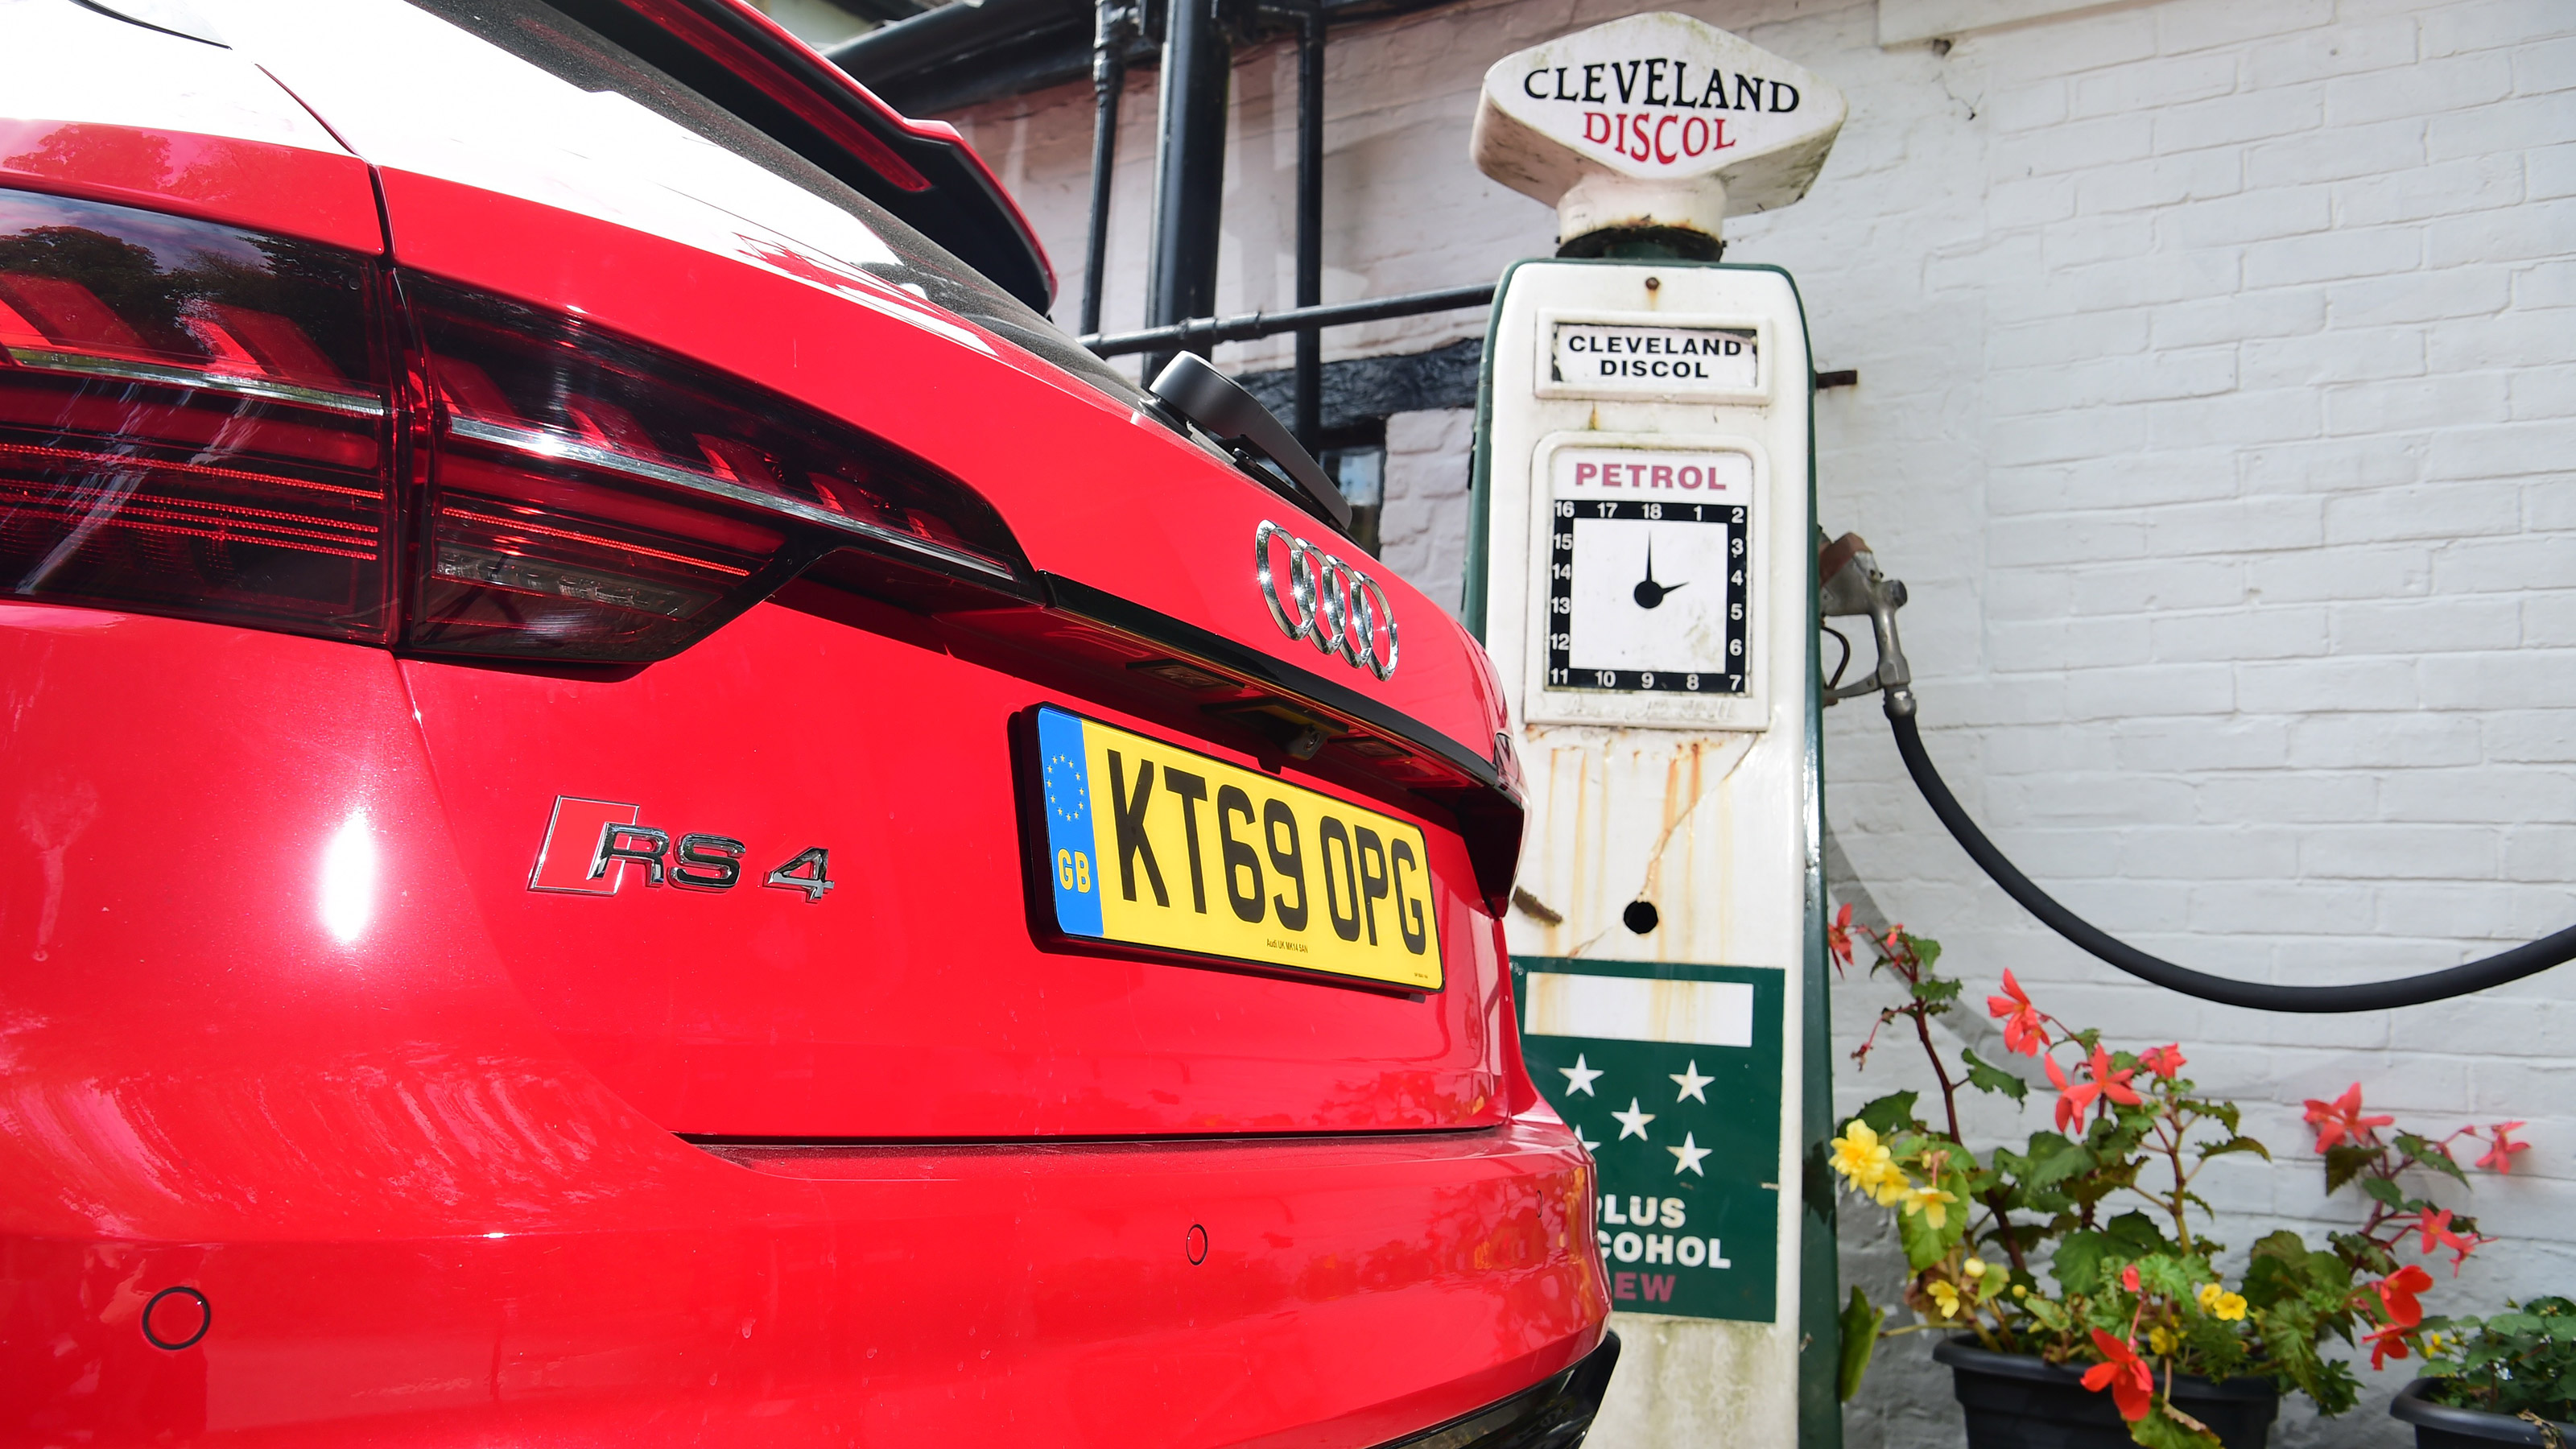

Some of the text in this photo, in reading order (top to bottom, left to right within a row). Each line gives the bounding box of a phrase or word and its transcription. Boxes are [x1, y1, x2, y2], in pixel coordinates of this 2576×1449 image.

[1524, 58, 1800, 113] CLEVELAND
[1583, 112, 1736, 164] DISCOL
[1568, 335, 1741, 357] CLEVELAND
[1600, 360, 1708, 379] DISCOL
[1575, 463, 1727, 490] PETROL
[1555, 502, 1744, 523] 16 17 18 1 2
[1554, 533, 1573, 550] 15
[1731, 538, 1744, 555] 3
[1552, 564, 1571, 580] 14
[1731, 570, 1743, 585] 4
[1551, 597, 1571, 614] 13
[1731, 605, 1743, 620] 5
[1550, 634, 1570, 650] 12
[1730, 639, 1742, 655] 6
[1550, 668, 1742, 691] 11 10 9 8 7
[586, 822, 835, 902] RS 4
[1107, 748, 1426, 956] KT69 OPG
[1058, 848, 1091, 894] GB
[1614, 1271, 1676, 1302] EW
